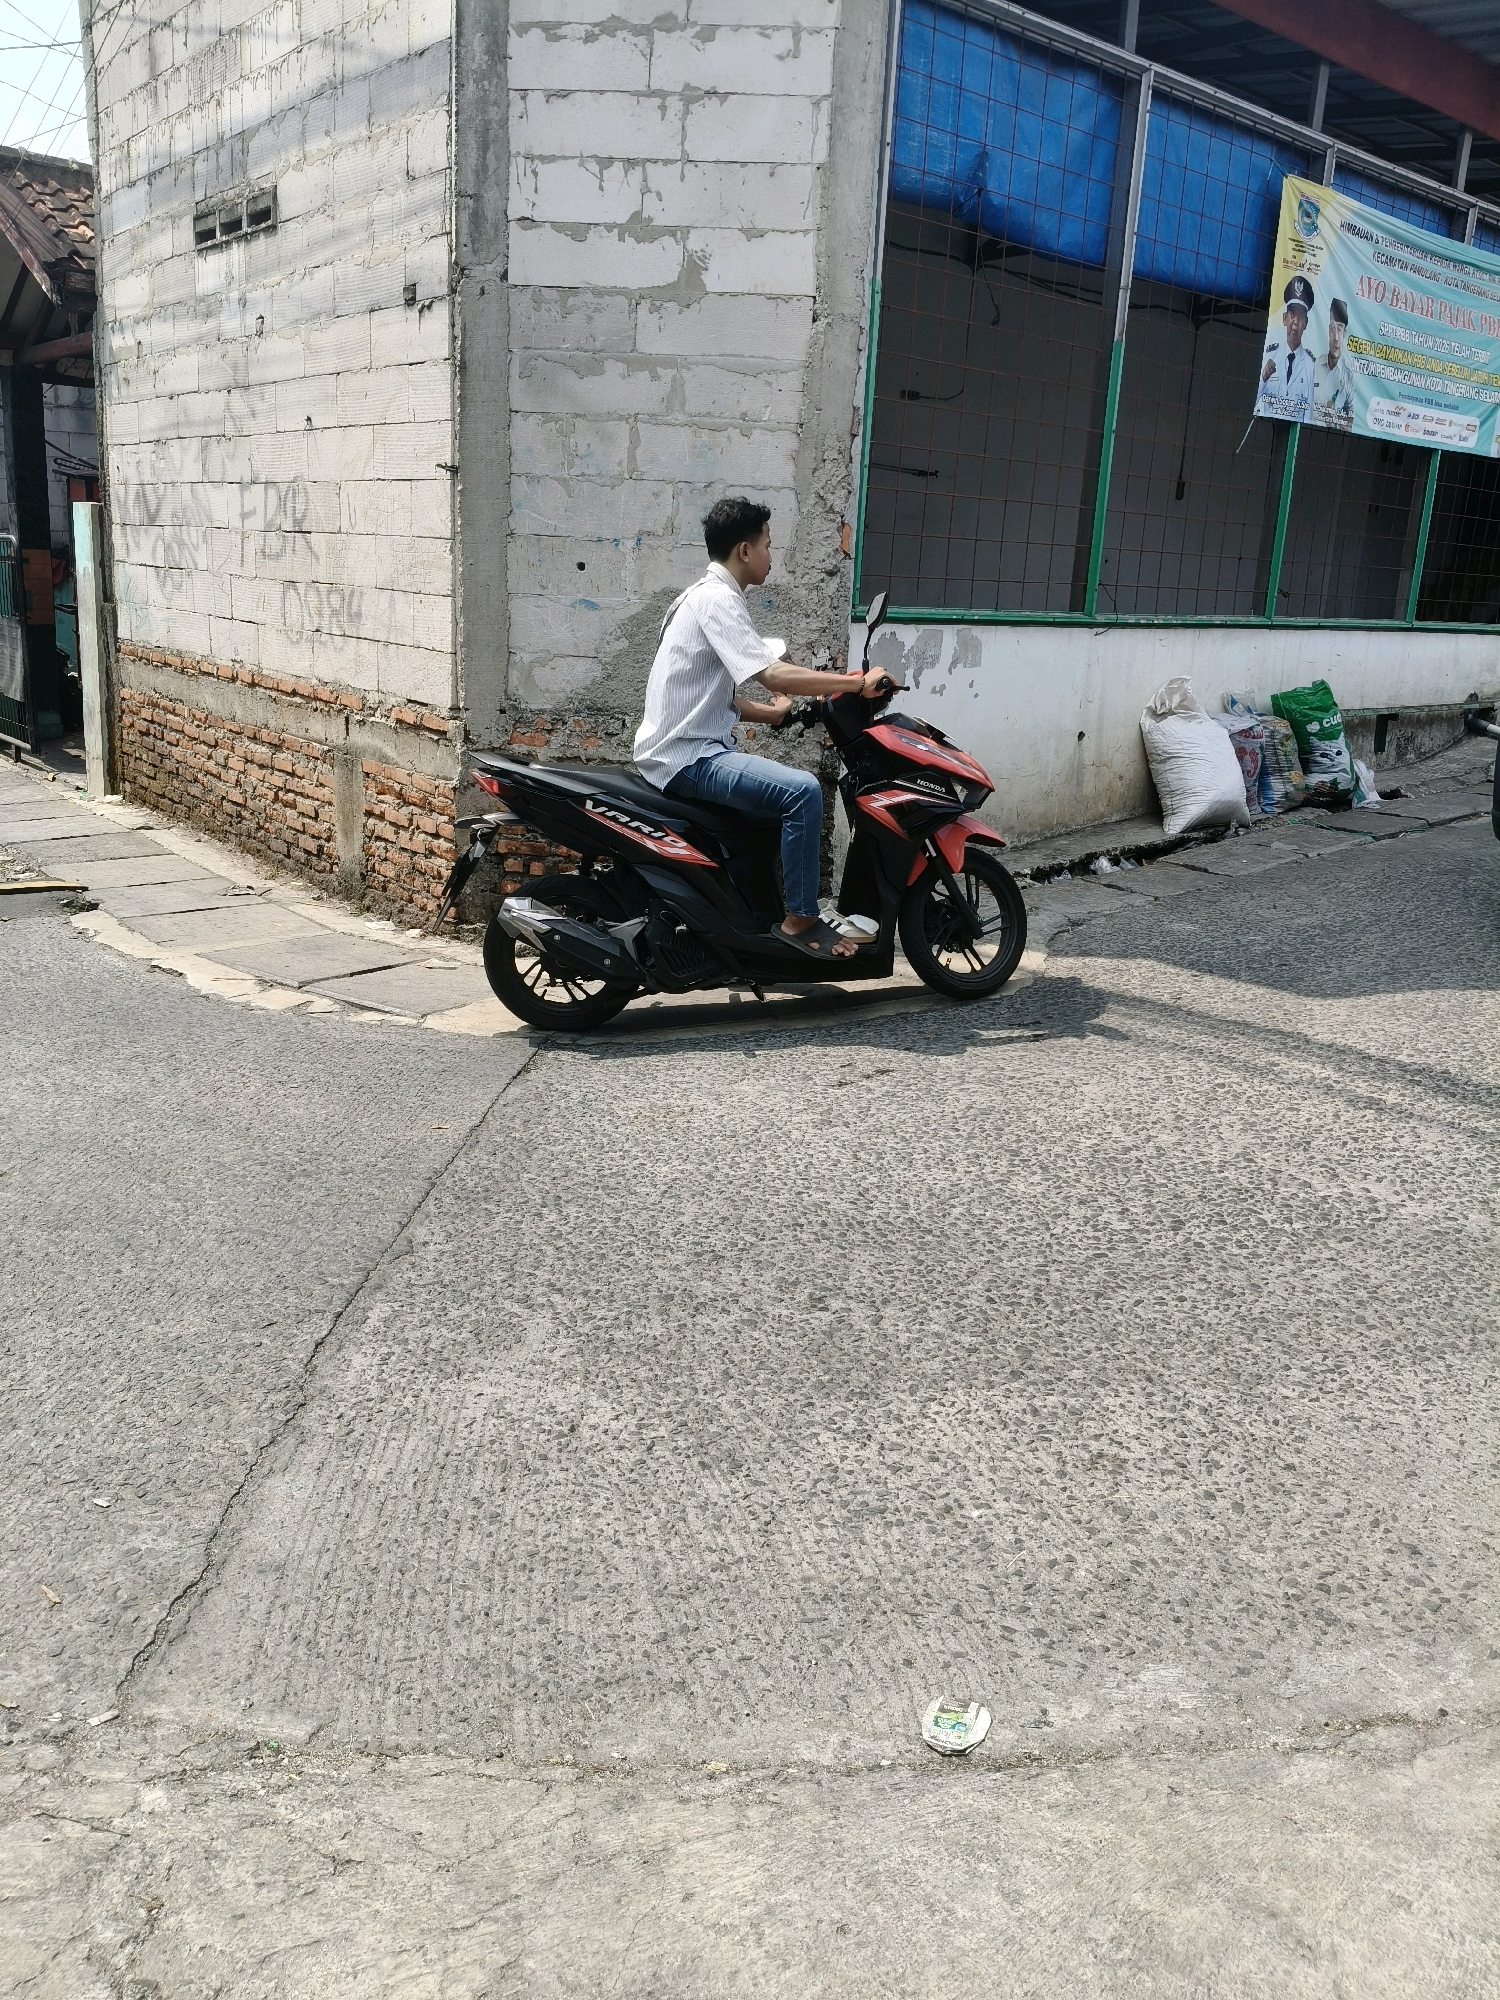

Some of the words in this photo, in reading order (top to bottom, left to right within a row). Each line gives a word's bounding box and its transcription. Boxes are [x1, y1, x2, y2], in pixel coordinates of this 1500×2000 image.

[1339, 219, 1374, 242] HIMBAUAN
[1374, 233, 1380, 245] &
[1372, 249, 1411, 273] KECAMATAN
[1410, 263, 1442, 283] PAMULANG
[1443, 275, 1459, 289] KOTA
[1459, 279, 1490, 299] TANGERANG
[1355, 274, 1388, 304] AYO
[1388, 284, 1434, 319] BAYAR
[1436, 300, 1477, 330] PAJAK
[1346, 335, 1375, 357] SEGERA
[1375, 342, 1414, 368] BAYARKAN
[1411, 331, 1434, 350] TAHUN
[1450, 340, 1471, 361] TELAH
[1425, 375, 1443, 394] KOTA
[1443, 377, 1479, 400] TANGERANG
[916, 778, 946, 793] HONDA
[584, 798, 688, 849] VARIO
